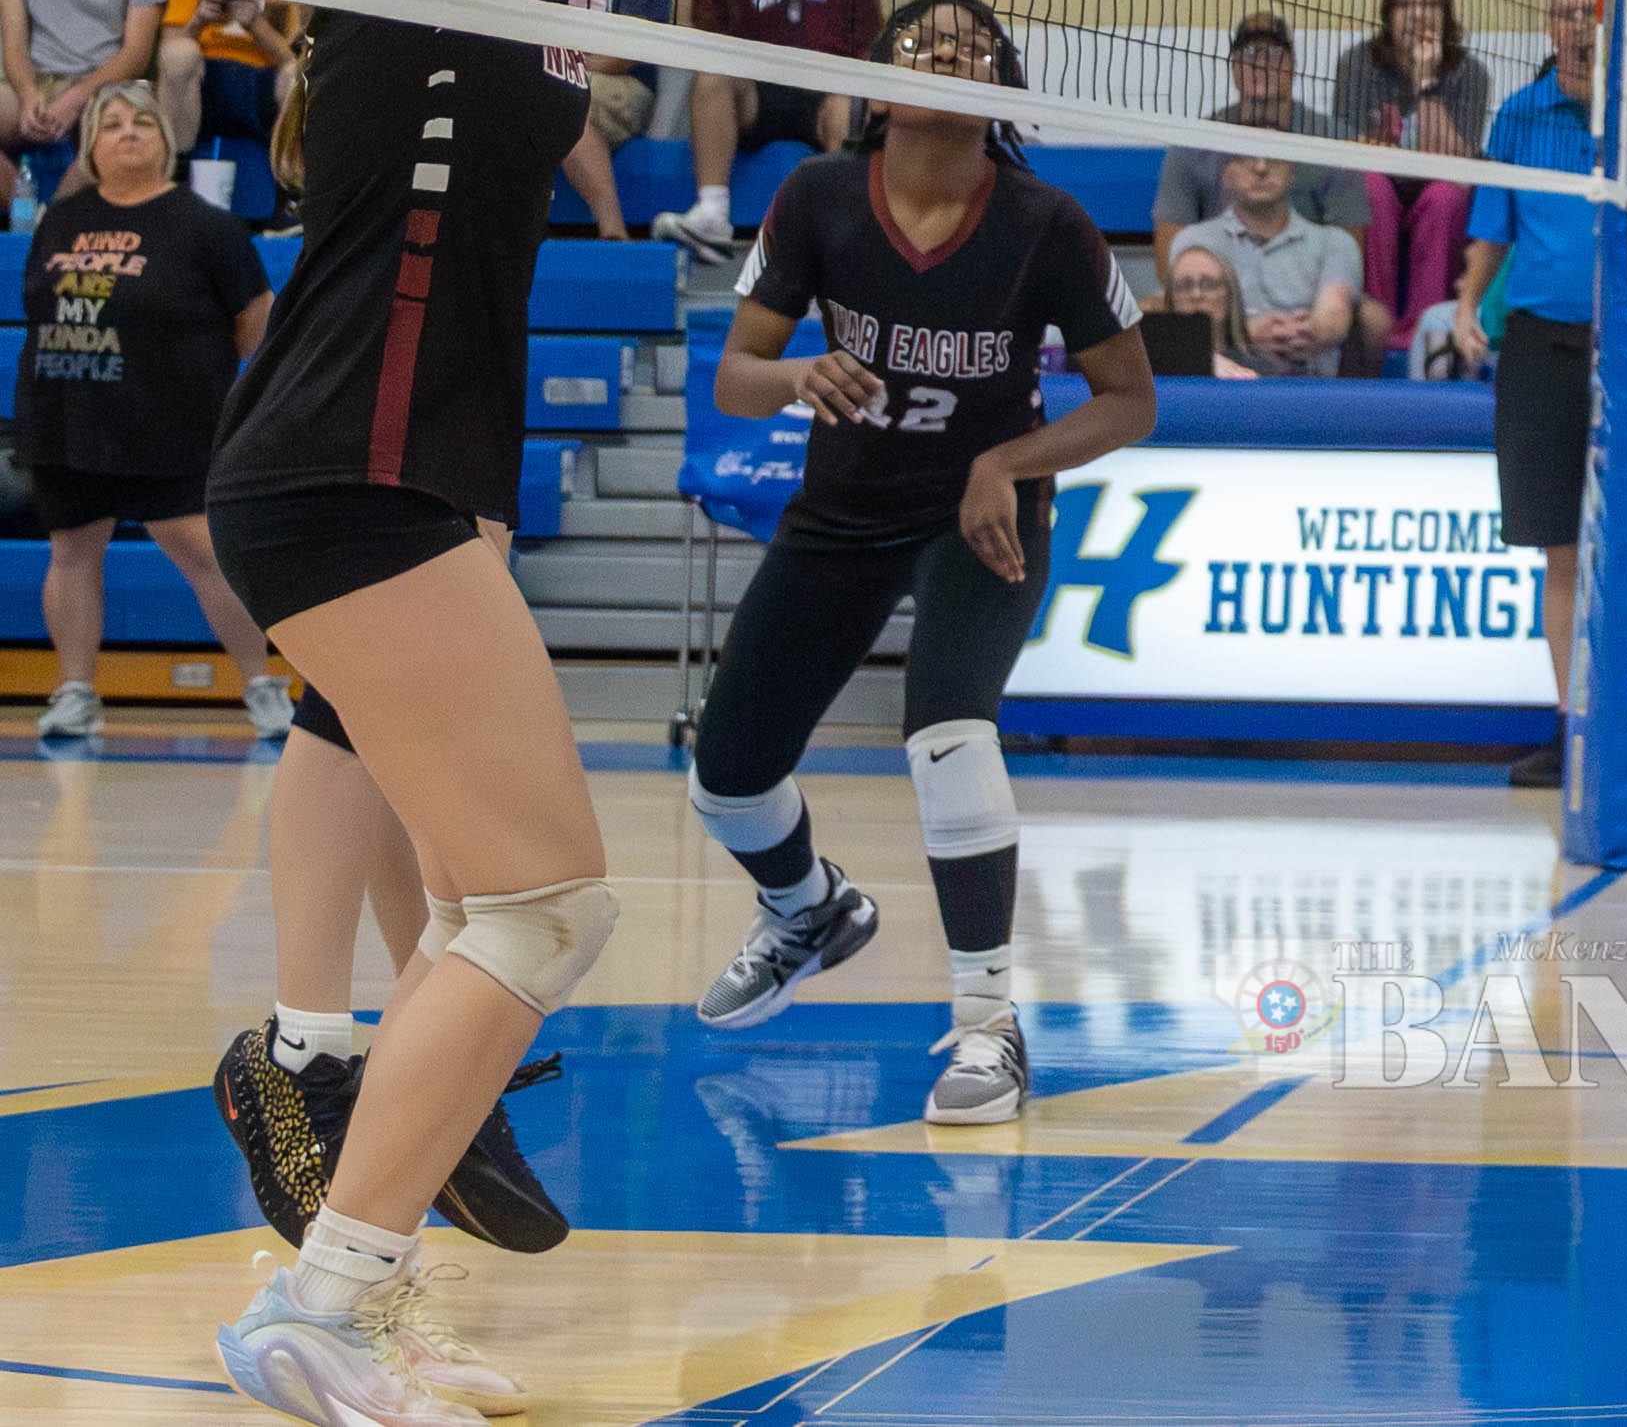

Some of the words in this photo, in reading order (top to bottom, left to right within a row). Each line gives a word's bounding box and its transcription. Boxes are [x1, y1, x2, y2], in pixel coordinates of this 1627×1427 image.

[71, 230, 142, 254] KIND
[44, 251, 148, 277] PEOPLE
[53, 272, 118, 299] ARE
[55, 295, 107, 324] MY
[36, 323, 122, 354] KINDA
[887, 323, 1014, 379] EAGLES
[34, 351, 125, 382] PEOPLE
[1297, 505, 1503, 555] WELCOME
